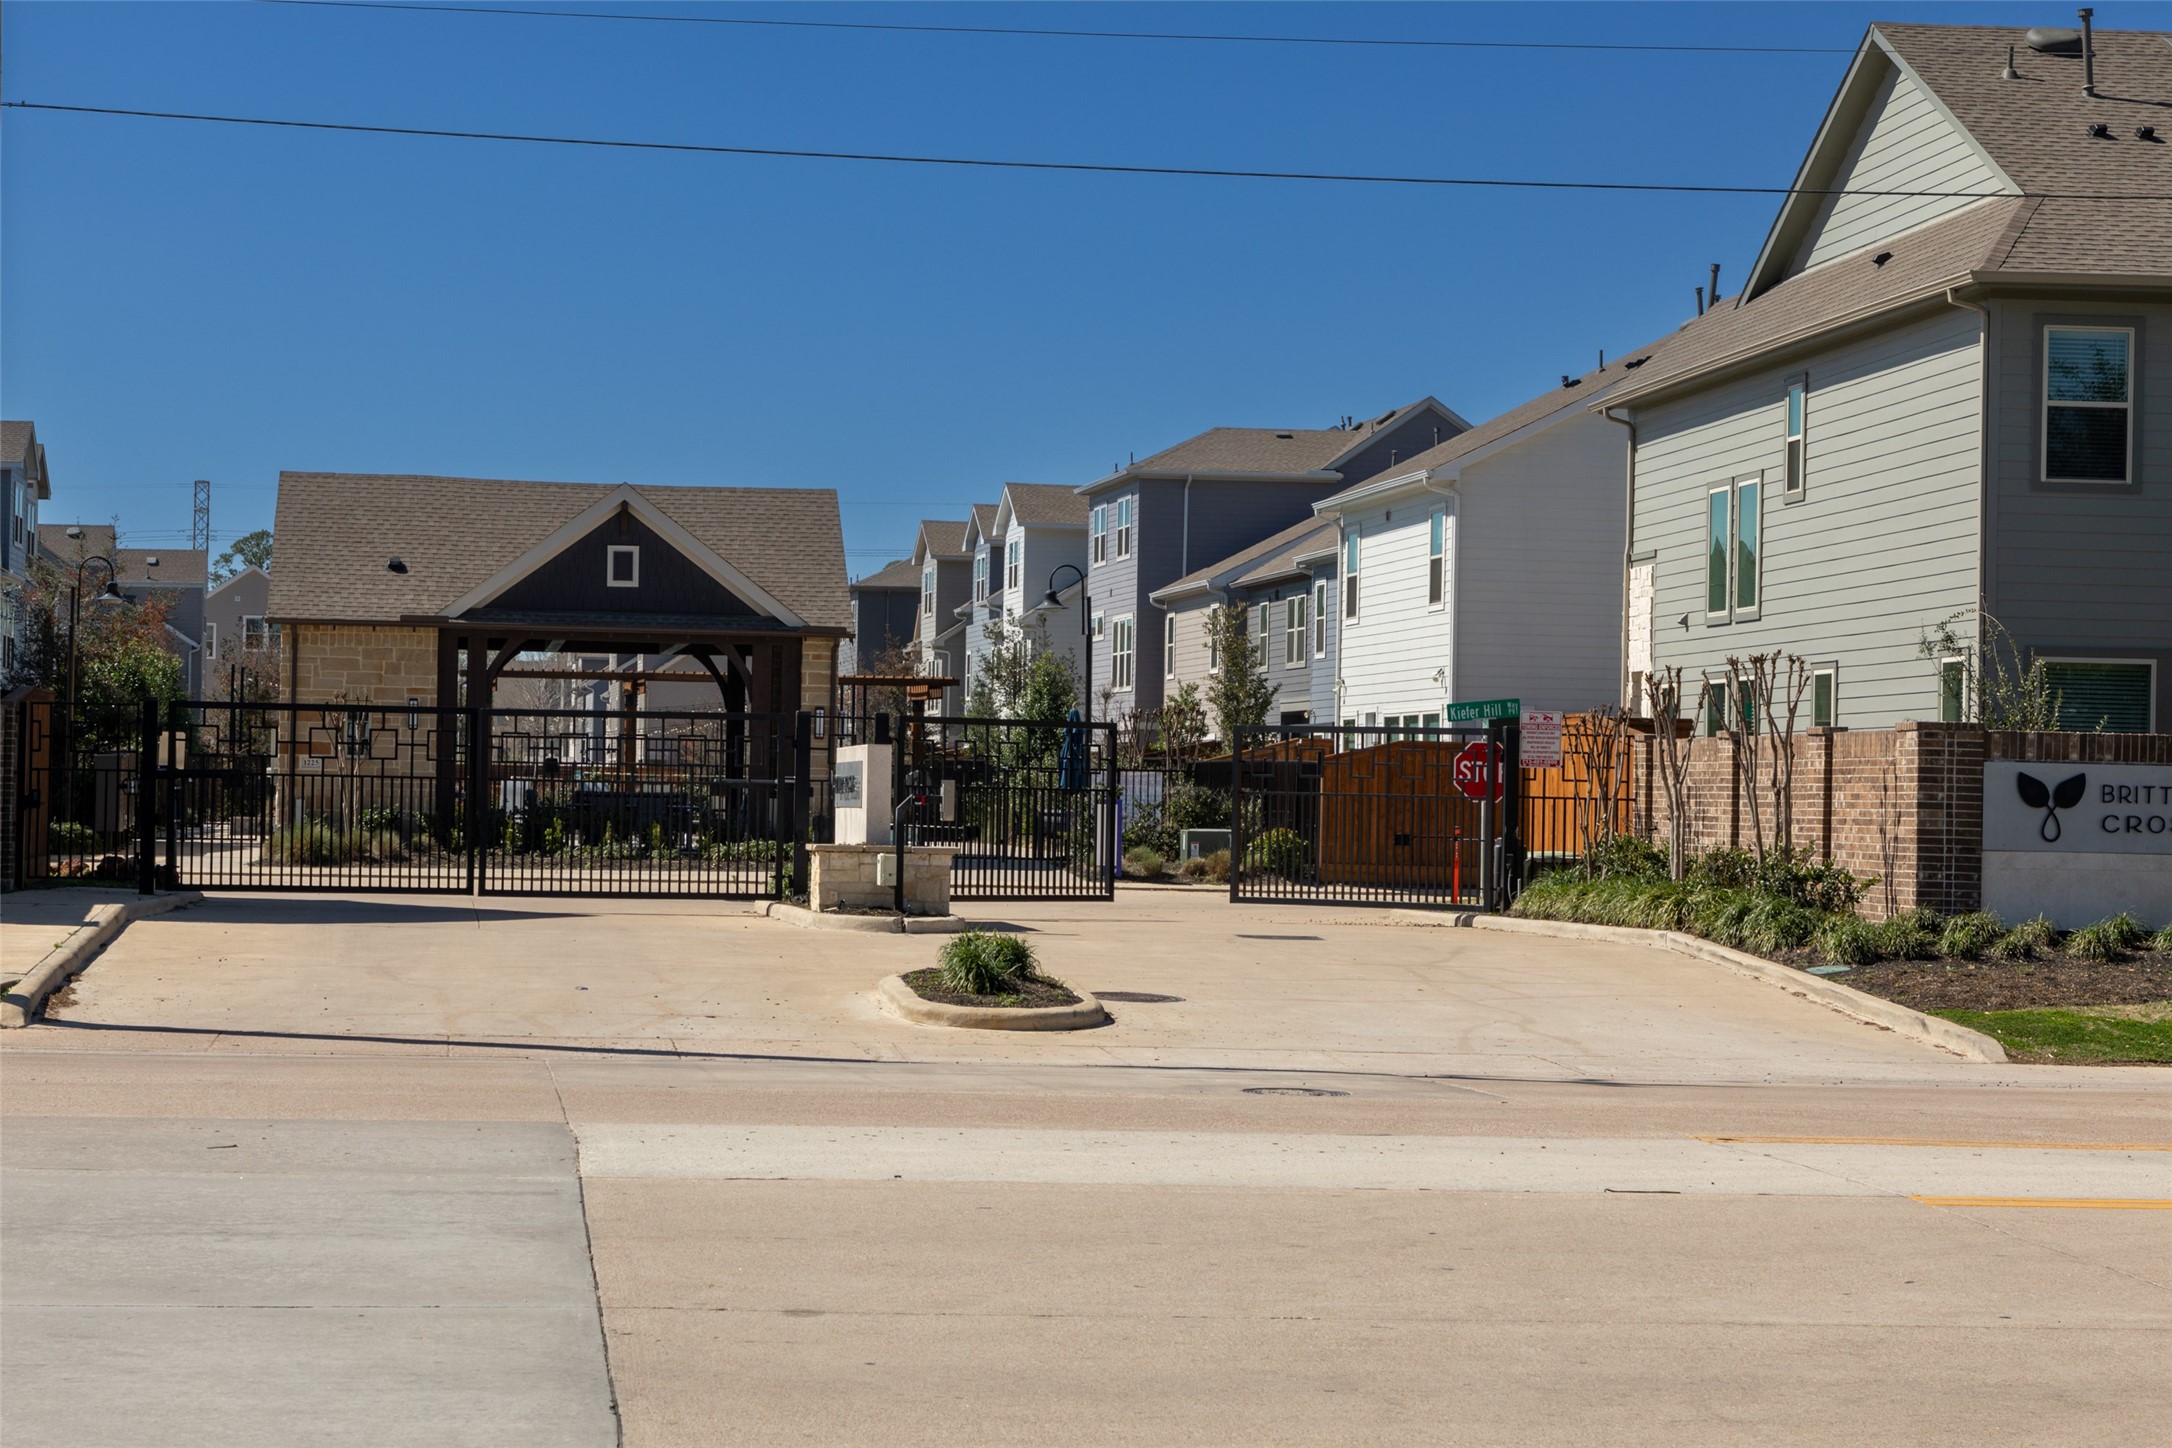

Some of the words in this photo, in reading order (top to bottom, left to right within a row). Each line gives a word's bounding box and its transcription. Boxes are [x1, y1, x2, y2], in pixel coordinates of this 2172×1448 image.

[1450, 705, 1479, 720] Kiefer
[1483, 703, 1502, 717] Hill
[2102, 784, 2172, 805] BRITT
[2102, 814, 2172, 834] CRO
